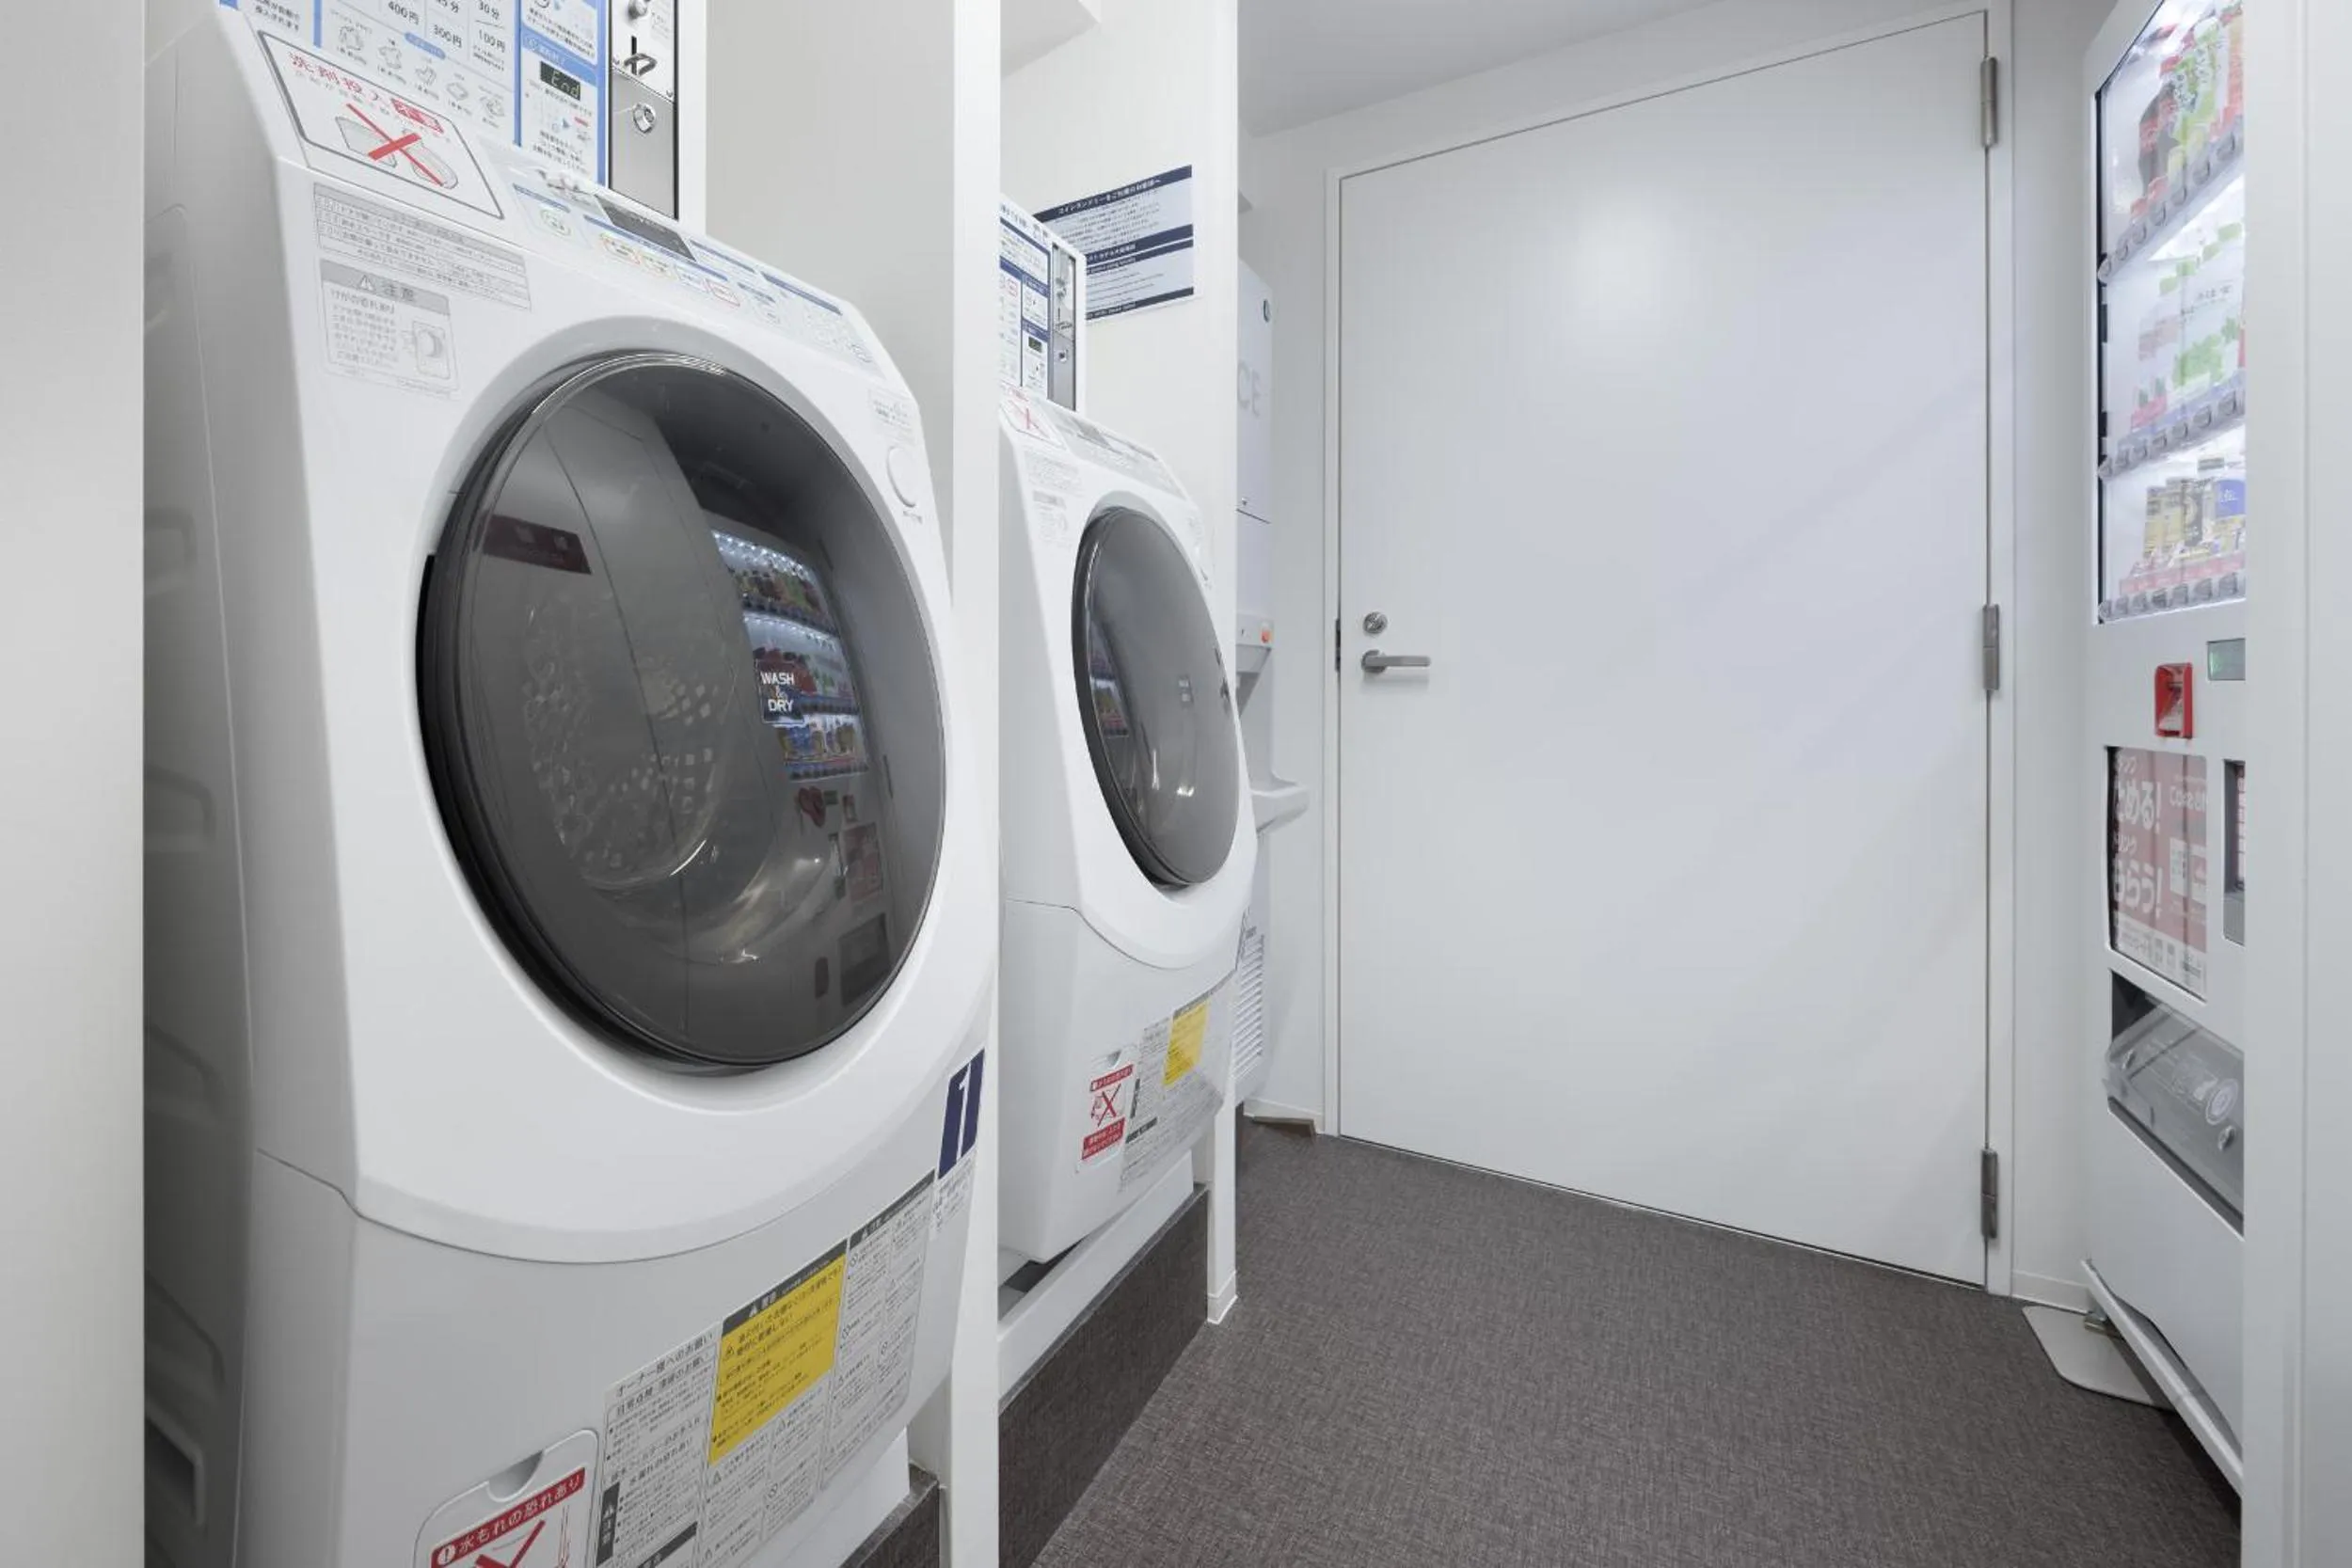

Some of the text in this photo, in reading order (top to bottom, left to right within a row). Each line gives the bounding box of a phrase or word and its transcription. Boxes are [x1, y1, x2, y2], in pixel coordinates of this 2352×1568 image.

[388, 1, 420, 25] 400円
[433, 24, 462, 48] 300円
[478, 29, 506, 53] 100円
[551, 70, 580, 100] End
[760, 672, 795, 686] WASH
[768, 699, 794, 712] DRY
[956, 1062, 971, 1164] 1
[458, 1474, 580, 1554] 水もれの恐れあり
